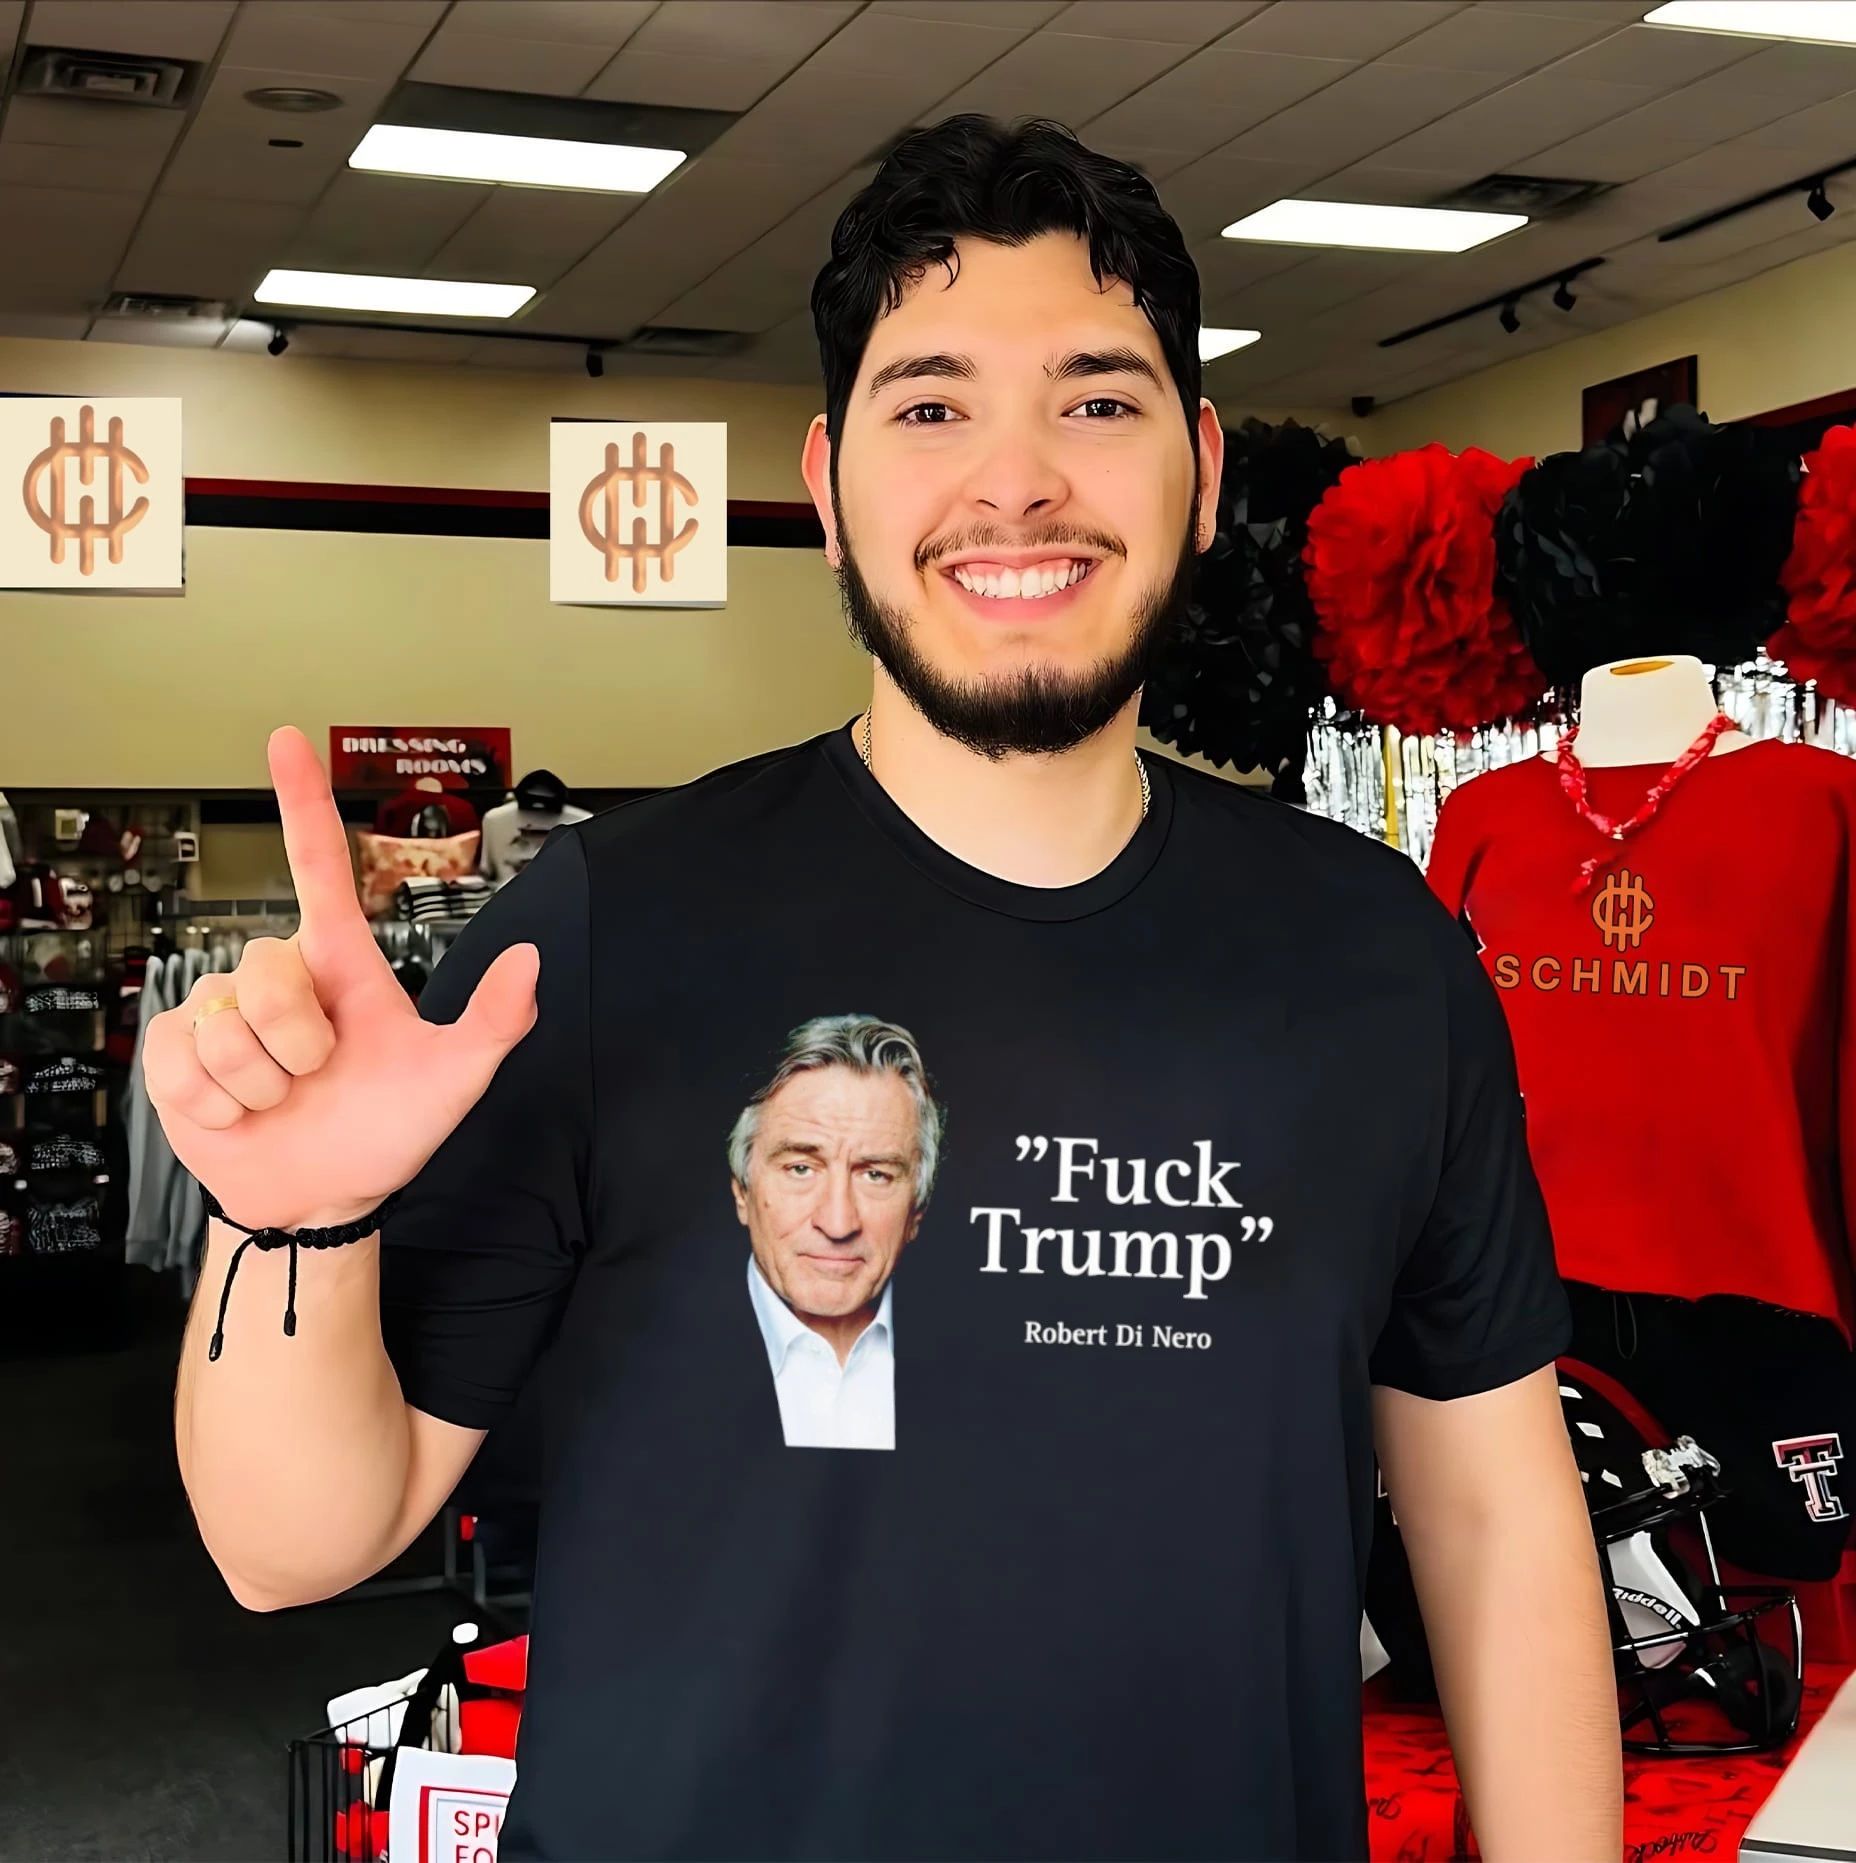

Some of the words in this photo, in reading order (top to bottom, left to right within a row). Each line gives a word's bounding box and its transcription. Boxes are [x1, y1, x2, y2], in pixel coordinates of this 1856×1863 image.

[342, 736, 467, 754] DRESSING
[396, 758, 487, 775] ROOMS
[1493, 954, 1747, 1000] SCHMIDT
[1024, 1321, 1108, 1346] Robert
[1115, 1323, 1144, 1347] Di
[1152, 1325, 1213, 1350] Nero
